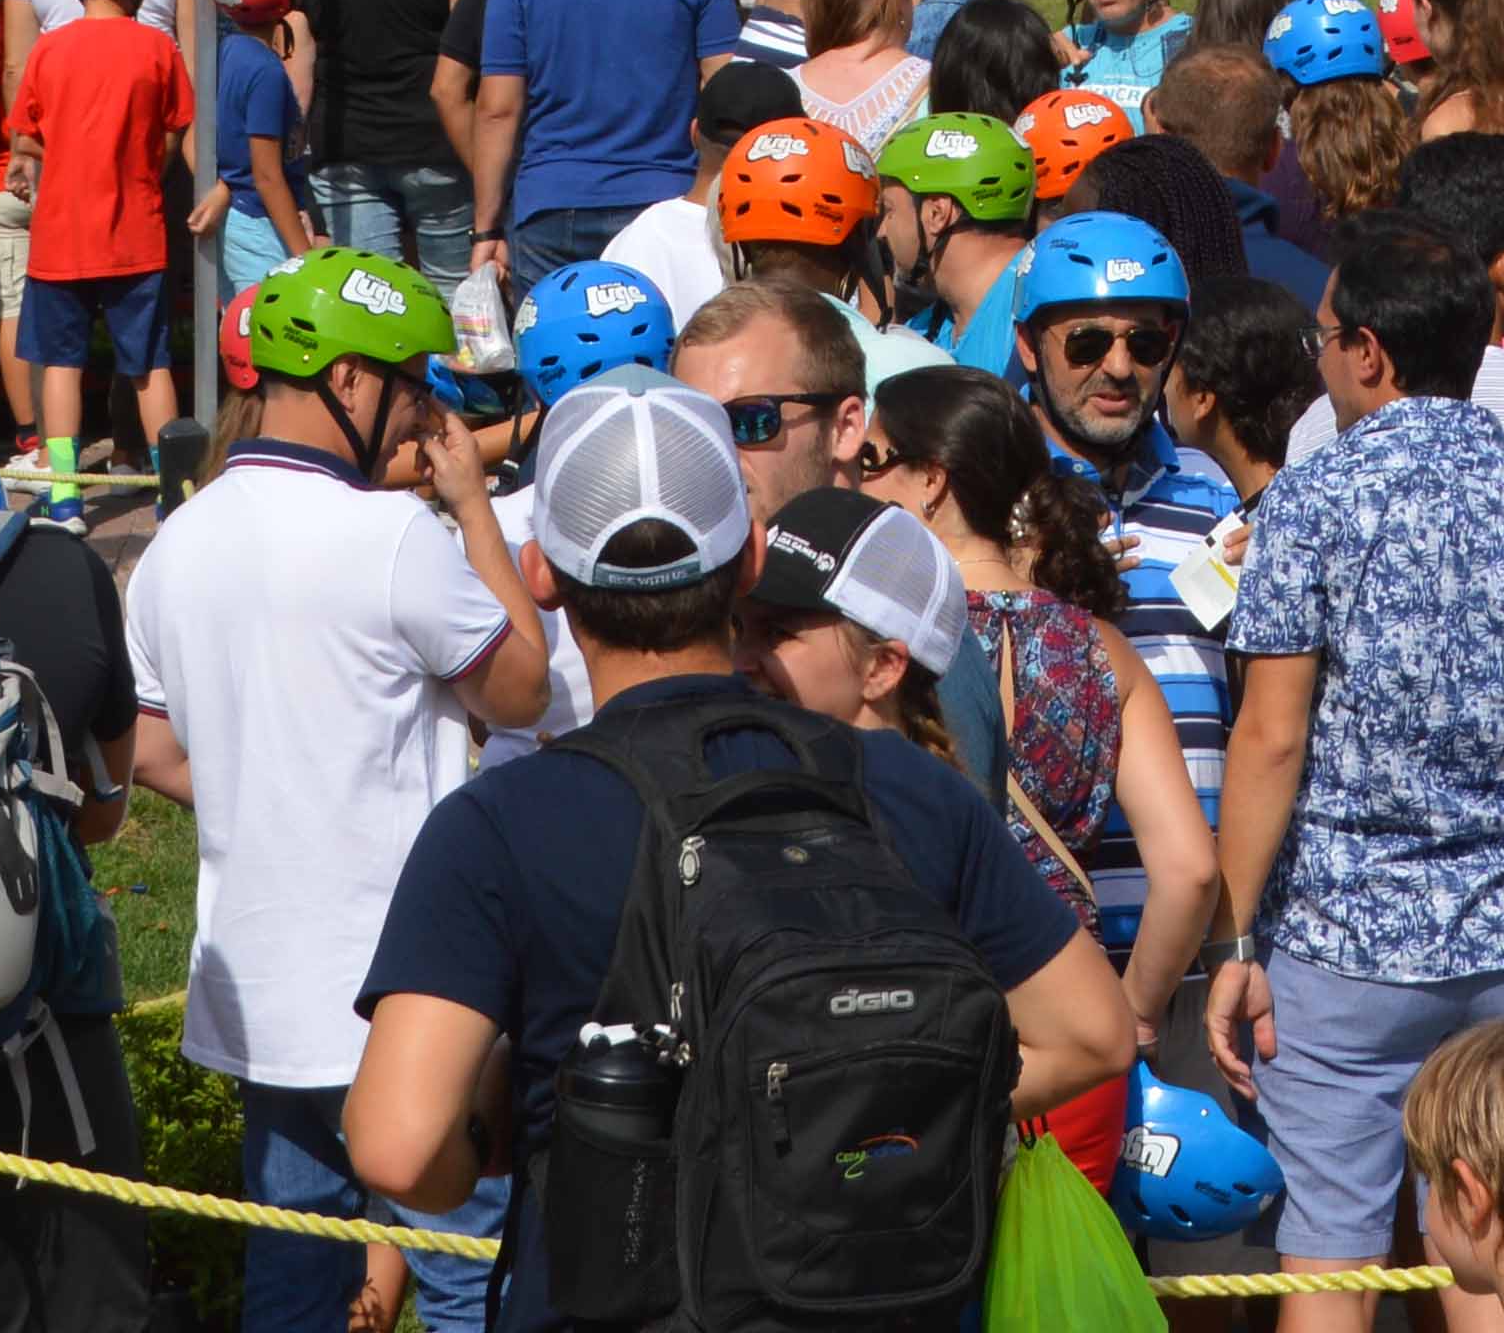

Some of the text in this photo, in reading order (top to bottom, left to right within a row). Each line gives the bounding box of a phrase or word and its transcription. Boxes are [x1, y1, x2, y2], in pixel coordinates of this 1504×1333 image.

[747, 135, 809, 162] Luge
[1106, 259, 1146, 283] Luge
[342, 269, 408, 315] Luge
[586, 283, 648, 317] Luge
